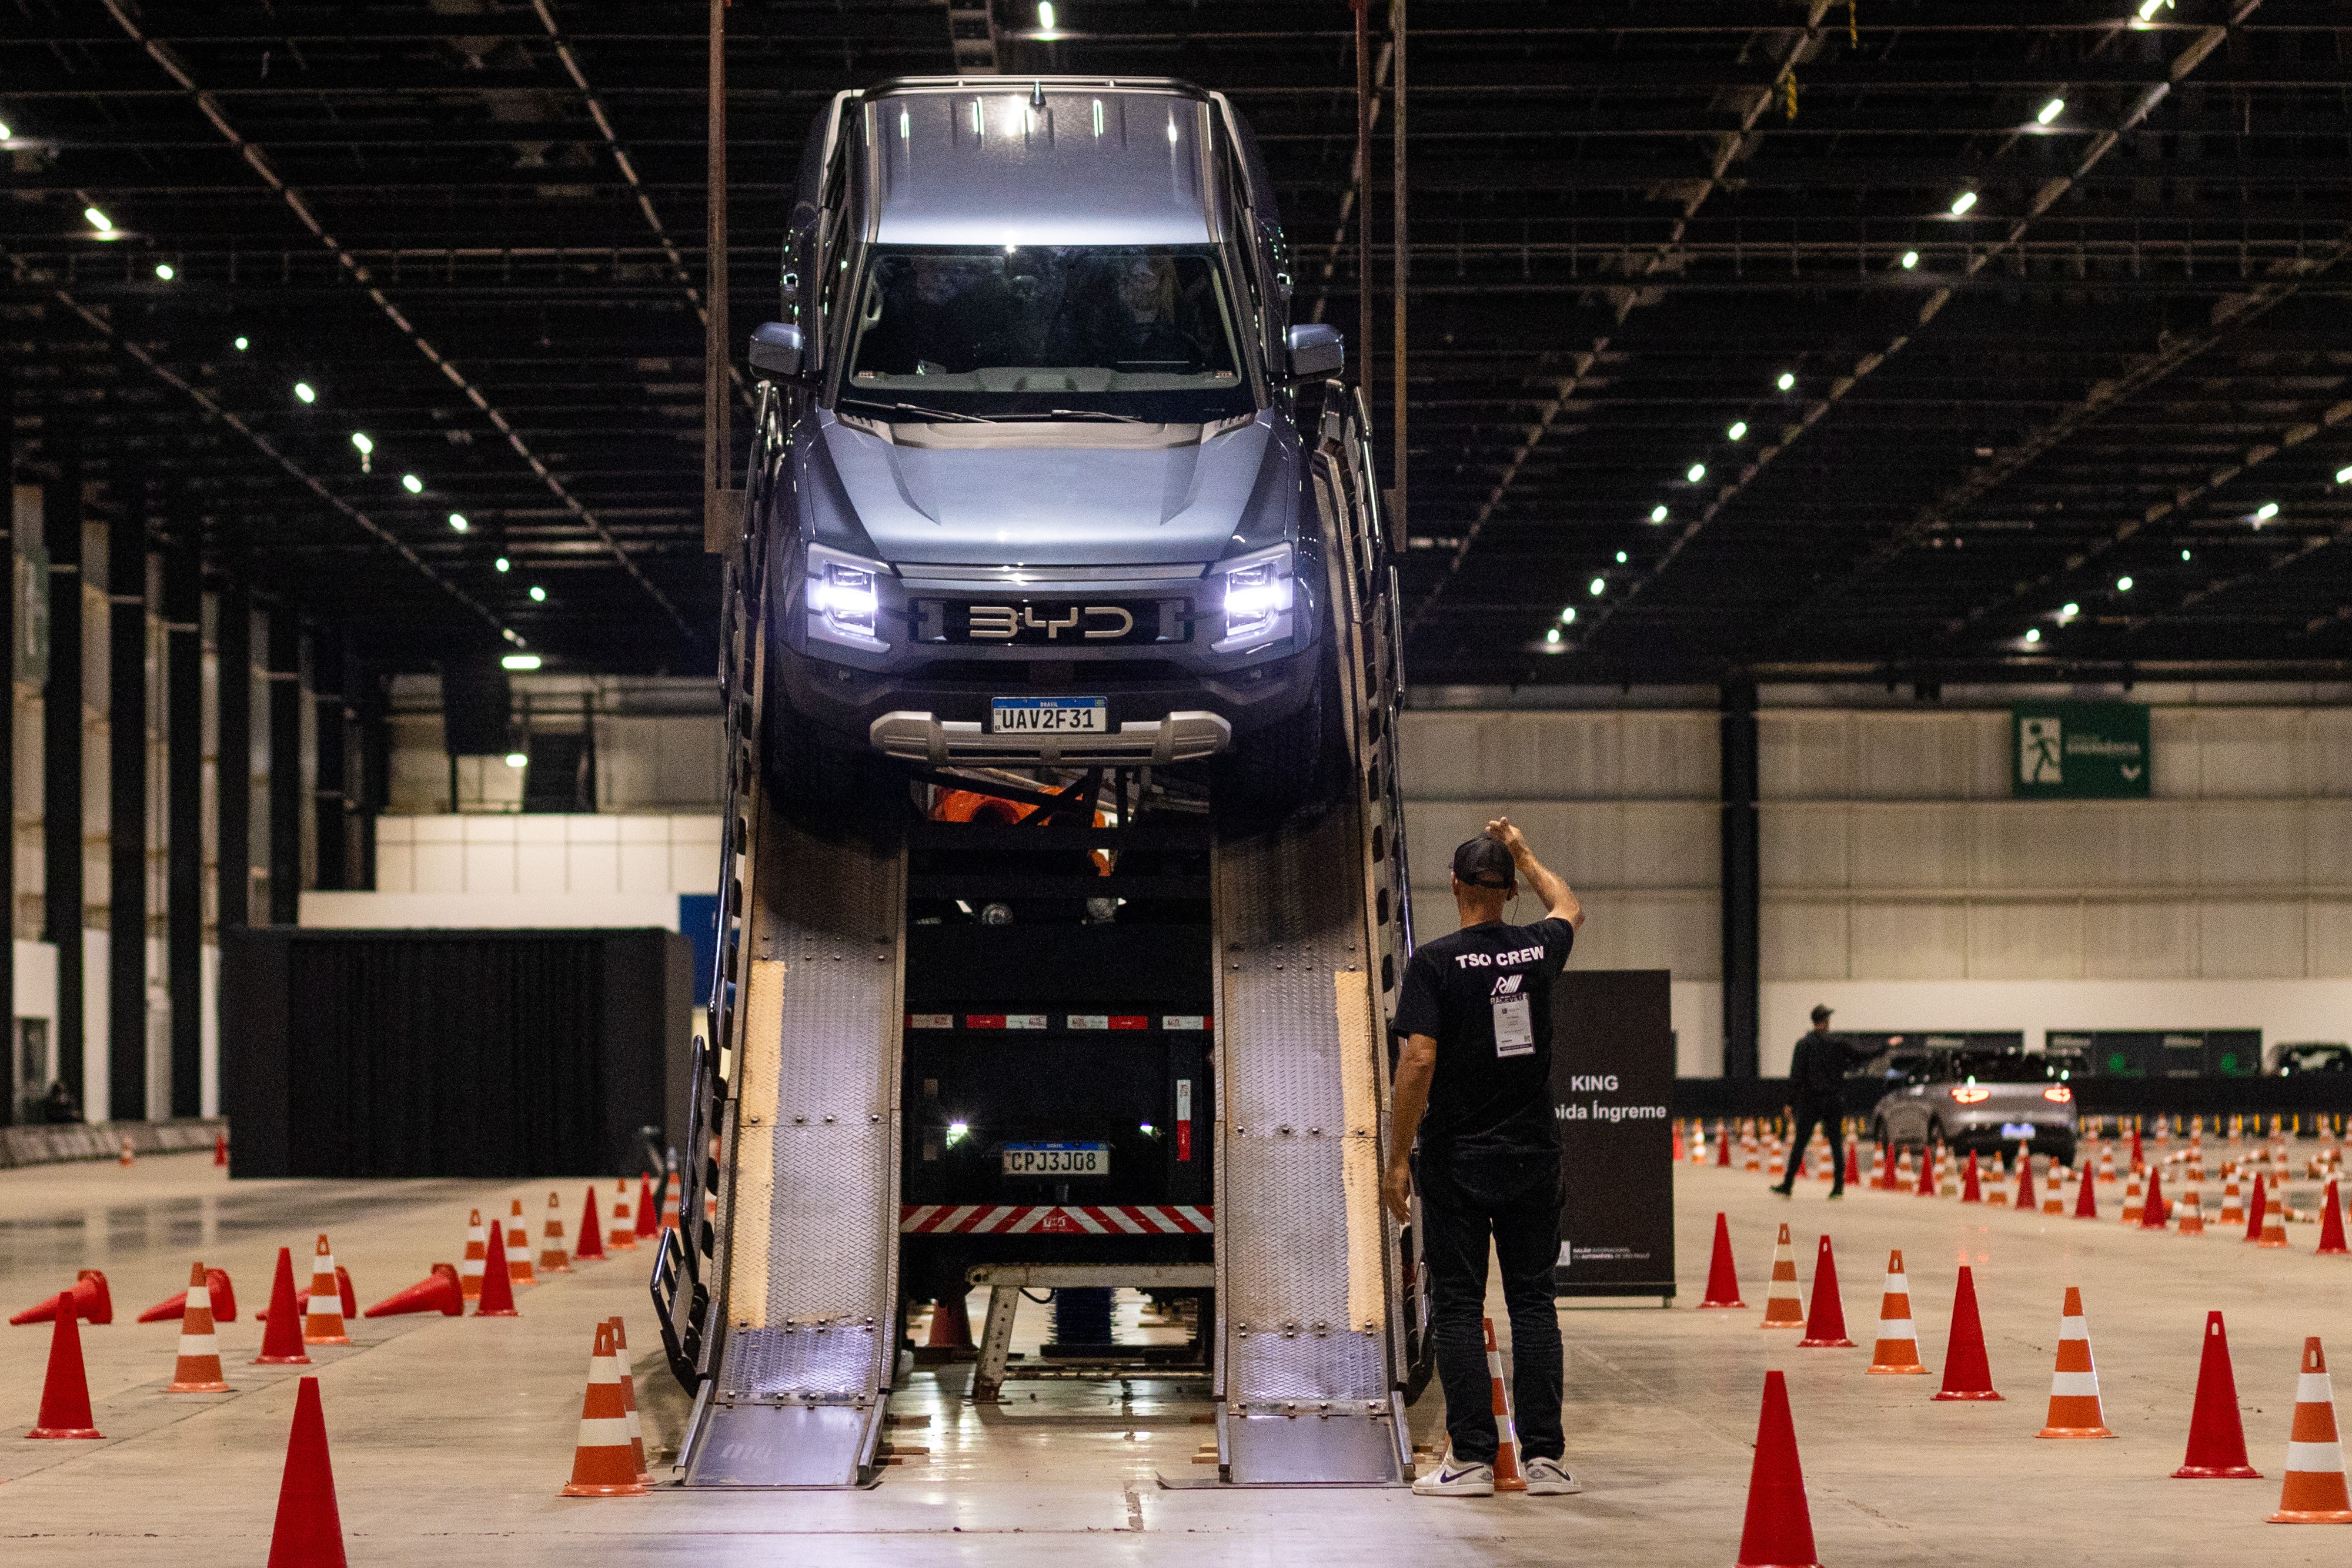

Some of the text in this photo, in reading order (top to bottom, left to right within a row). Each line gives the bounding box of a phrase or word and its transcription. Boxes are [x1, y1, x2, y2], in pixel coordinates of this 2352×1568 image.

[970, 606, 1133, 638] BYD
[1003, 709, 1094, 728] UAV2F31
[1455, 945, 1544, 969] TSO CREW
[1571, 1075, 1619, 1091] KING
[1593, 1100, 1666, 1123] Íngreme
[1011, 1152, 1096, 1171] CPJ3J08
